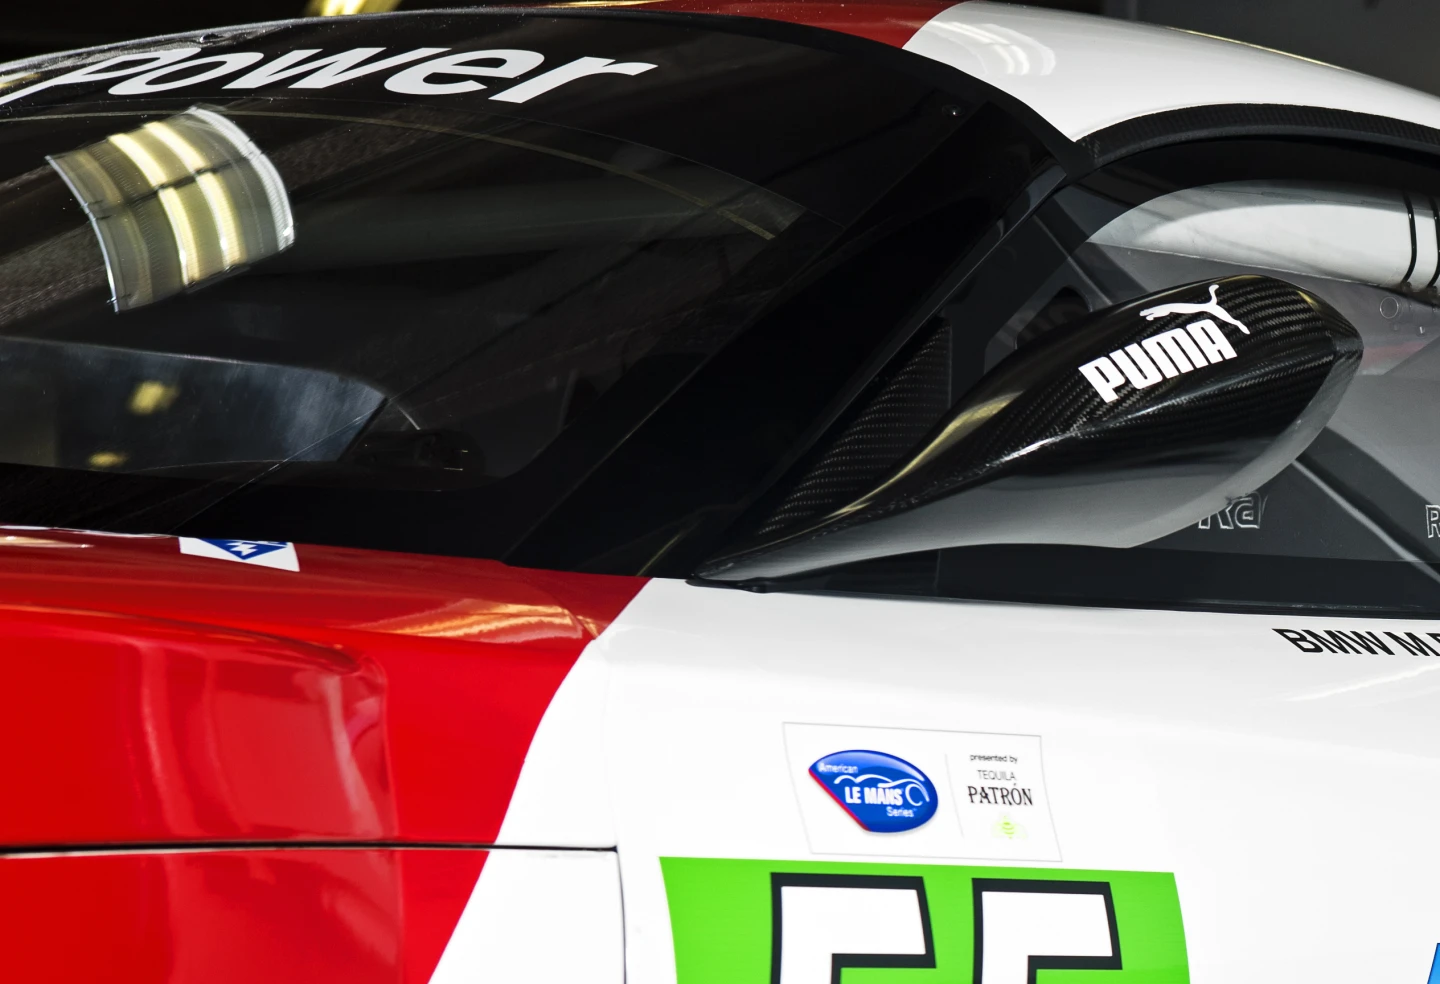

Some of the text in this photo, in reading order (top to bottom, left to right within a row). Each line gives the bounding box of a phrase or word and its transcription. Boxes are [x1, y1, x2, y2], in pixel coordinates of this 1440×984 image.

[0, 46, 658, 104] Power
[1078, 319, 1238, 402] PUMA
[1271, 627, 1390, 655] BMW
[817, 762, 859, 775] American
[969, 753, 1019, 765] presented by
[976, 768, 1017, 782] TEQUILA
[844, 786, 904, 806] LE MANS
[967, 782, 1034, 807] PATRÓN
[885, 805, 915, 818] Series
